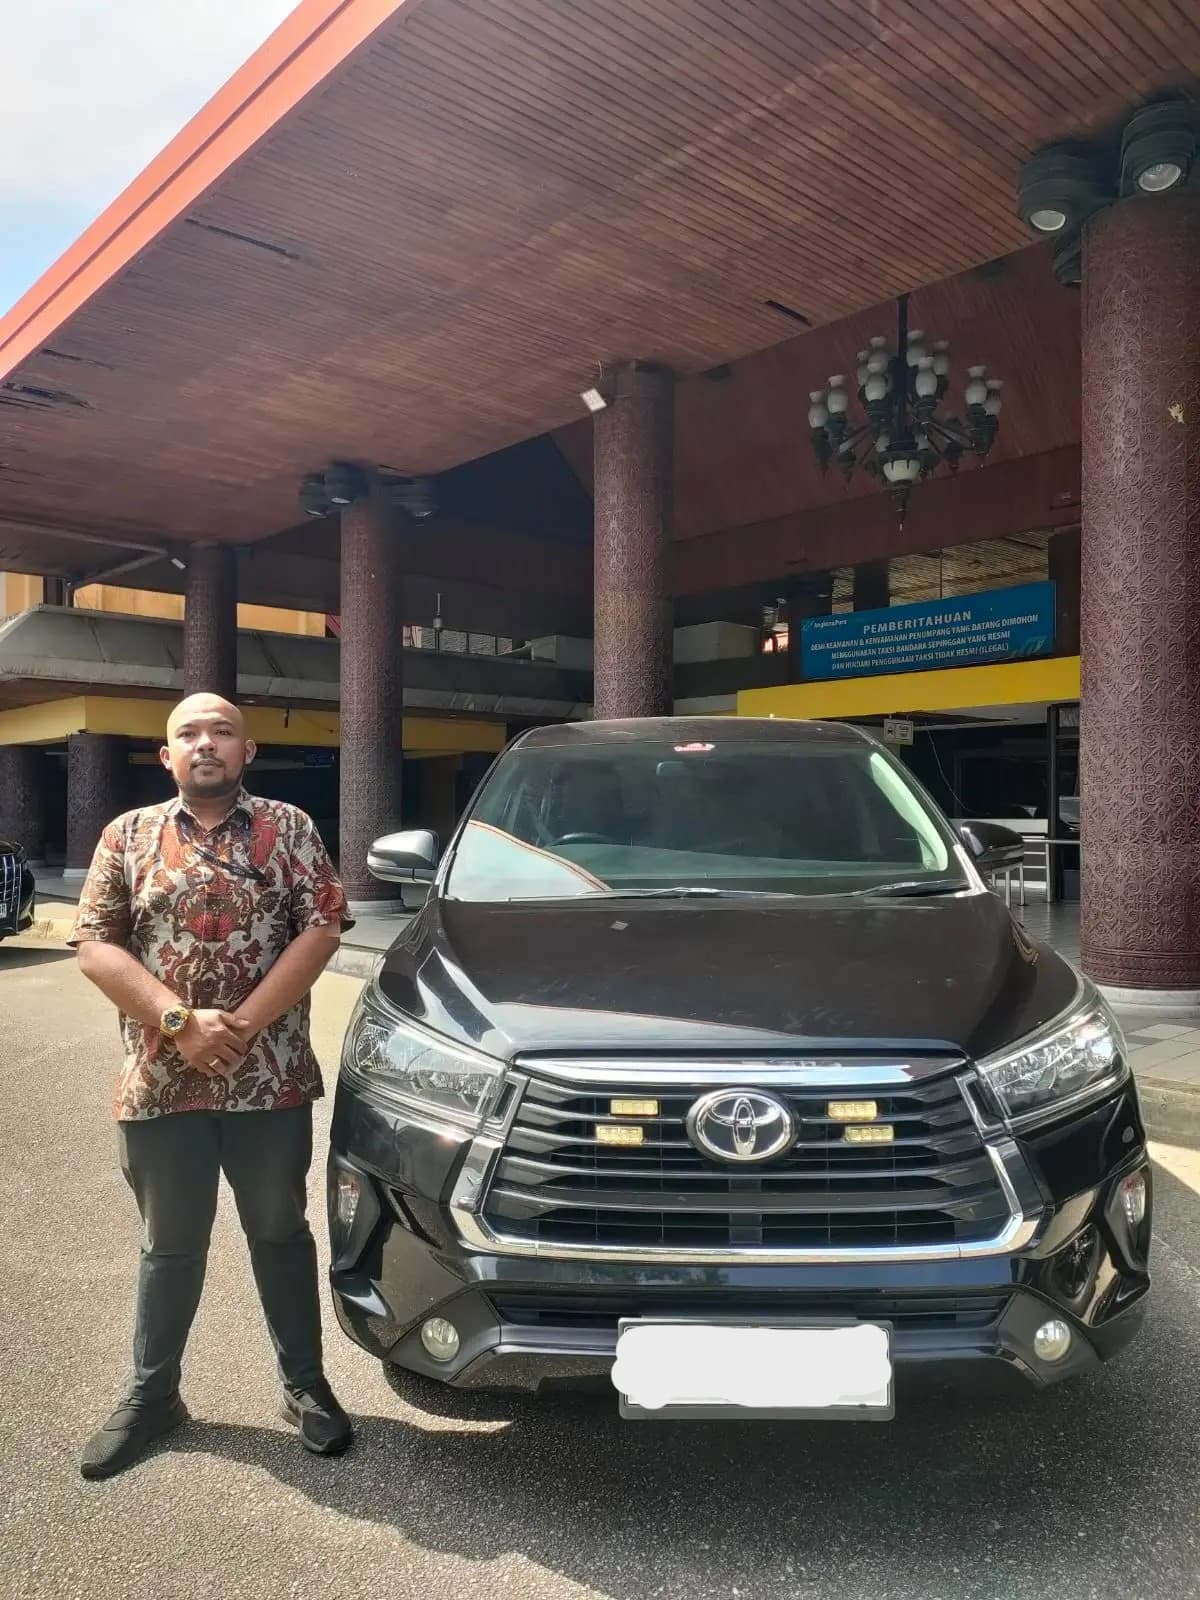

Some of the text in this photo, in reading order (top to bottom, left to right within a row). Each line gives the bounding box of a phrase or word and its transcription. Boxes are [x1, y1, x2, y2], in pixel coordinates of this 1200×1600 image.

[810, 643, 825, 651] DEMI
[826, 641, 858, 650] KEAMANAN
[865, 633, 907, 645] KENYAMANAN
[908, 626, 951, 640] PENUMPANG
[951, 625, 970, 634] YANG
[971, 620, 1000, 631] DATANG
[1001, 614, 1038, 627] DIMOHON
[863, 610, 972, 635] PEMBERITAHUAN
[831, 630, 1010, 659] MENGGUNAKAN TAKSI BANDARA SEPINGGAN YANG RESMI
[832, 643, 1009, 670] DAN HINDARI PENGGUNAAN TAKSI TIDAK RESMI (ILEGAL)
